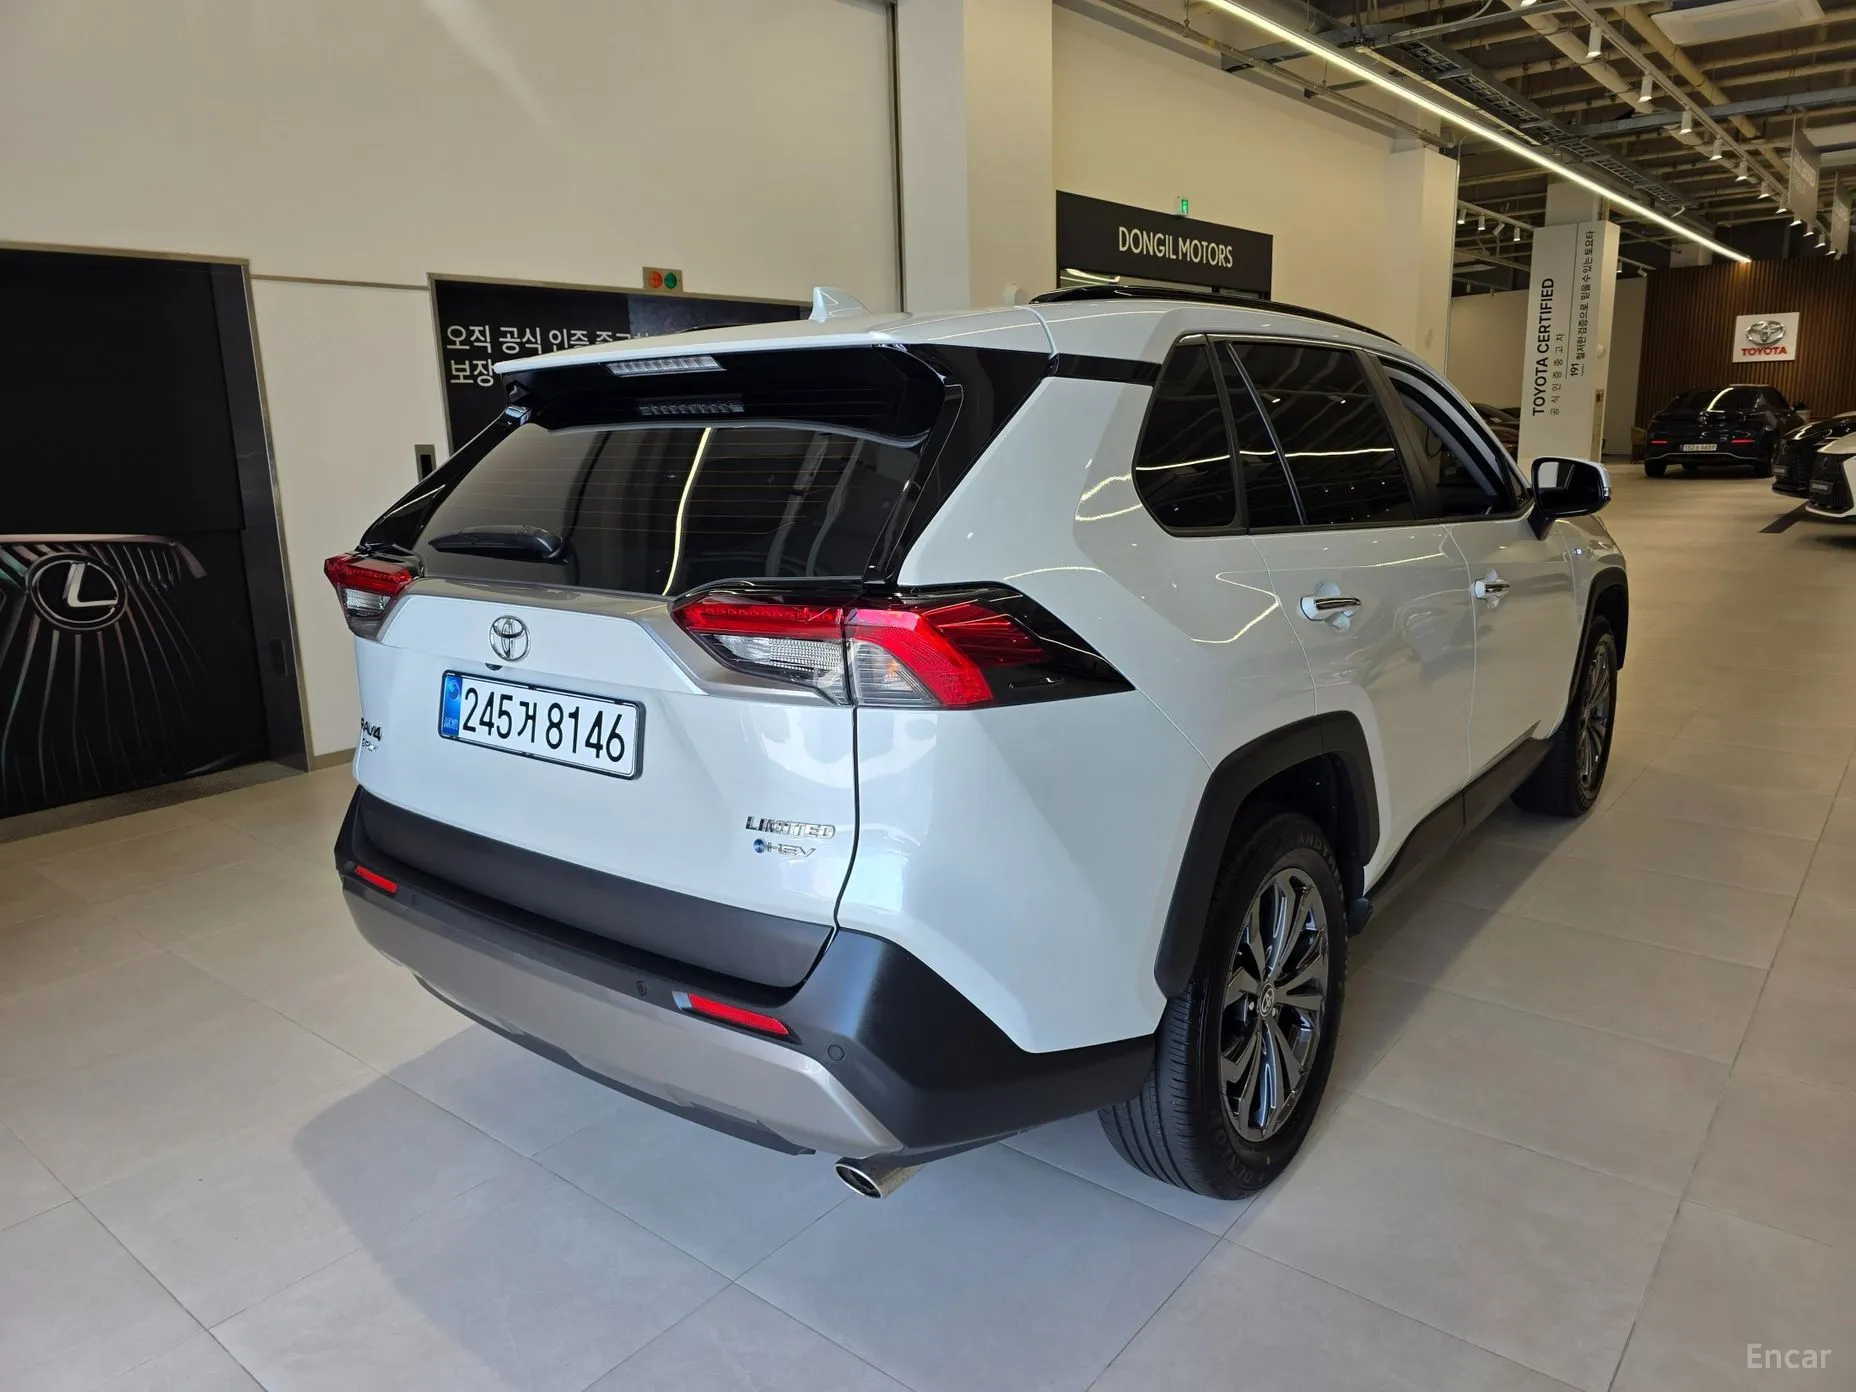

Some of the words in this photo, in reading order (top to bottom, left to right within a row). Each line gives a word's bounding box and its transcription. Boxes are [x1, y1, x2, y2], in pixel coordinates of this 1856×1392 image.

[1118, 226, 1176, 259] DONGIL
[1178, 237, 1233, 268] MOTORS
[1537, 278, 1555, 354] CERTIFIED
[1577, 303, 1589, 335] 검증으로
[446, 325, 492, 354] 오직
[499, 327, 543, 354] 공식
[1741, 345, 1788, 357] TOYOTA
[450, 359, 496, 387] 보장
[1570, 363, 1580, 377] 191
[1532, 357, 1549, 416] TOYOTA
[462, 687, 538, 744] 245거
[545, 702, 626, 763] 8146
[745, 816, 836, 839] LIMITED
[766, 842, 817, 857] HEV
